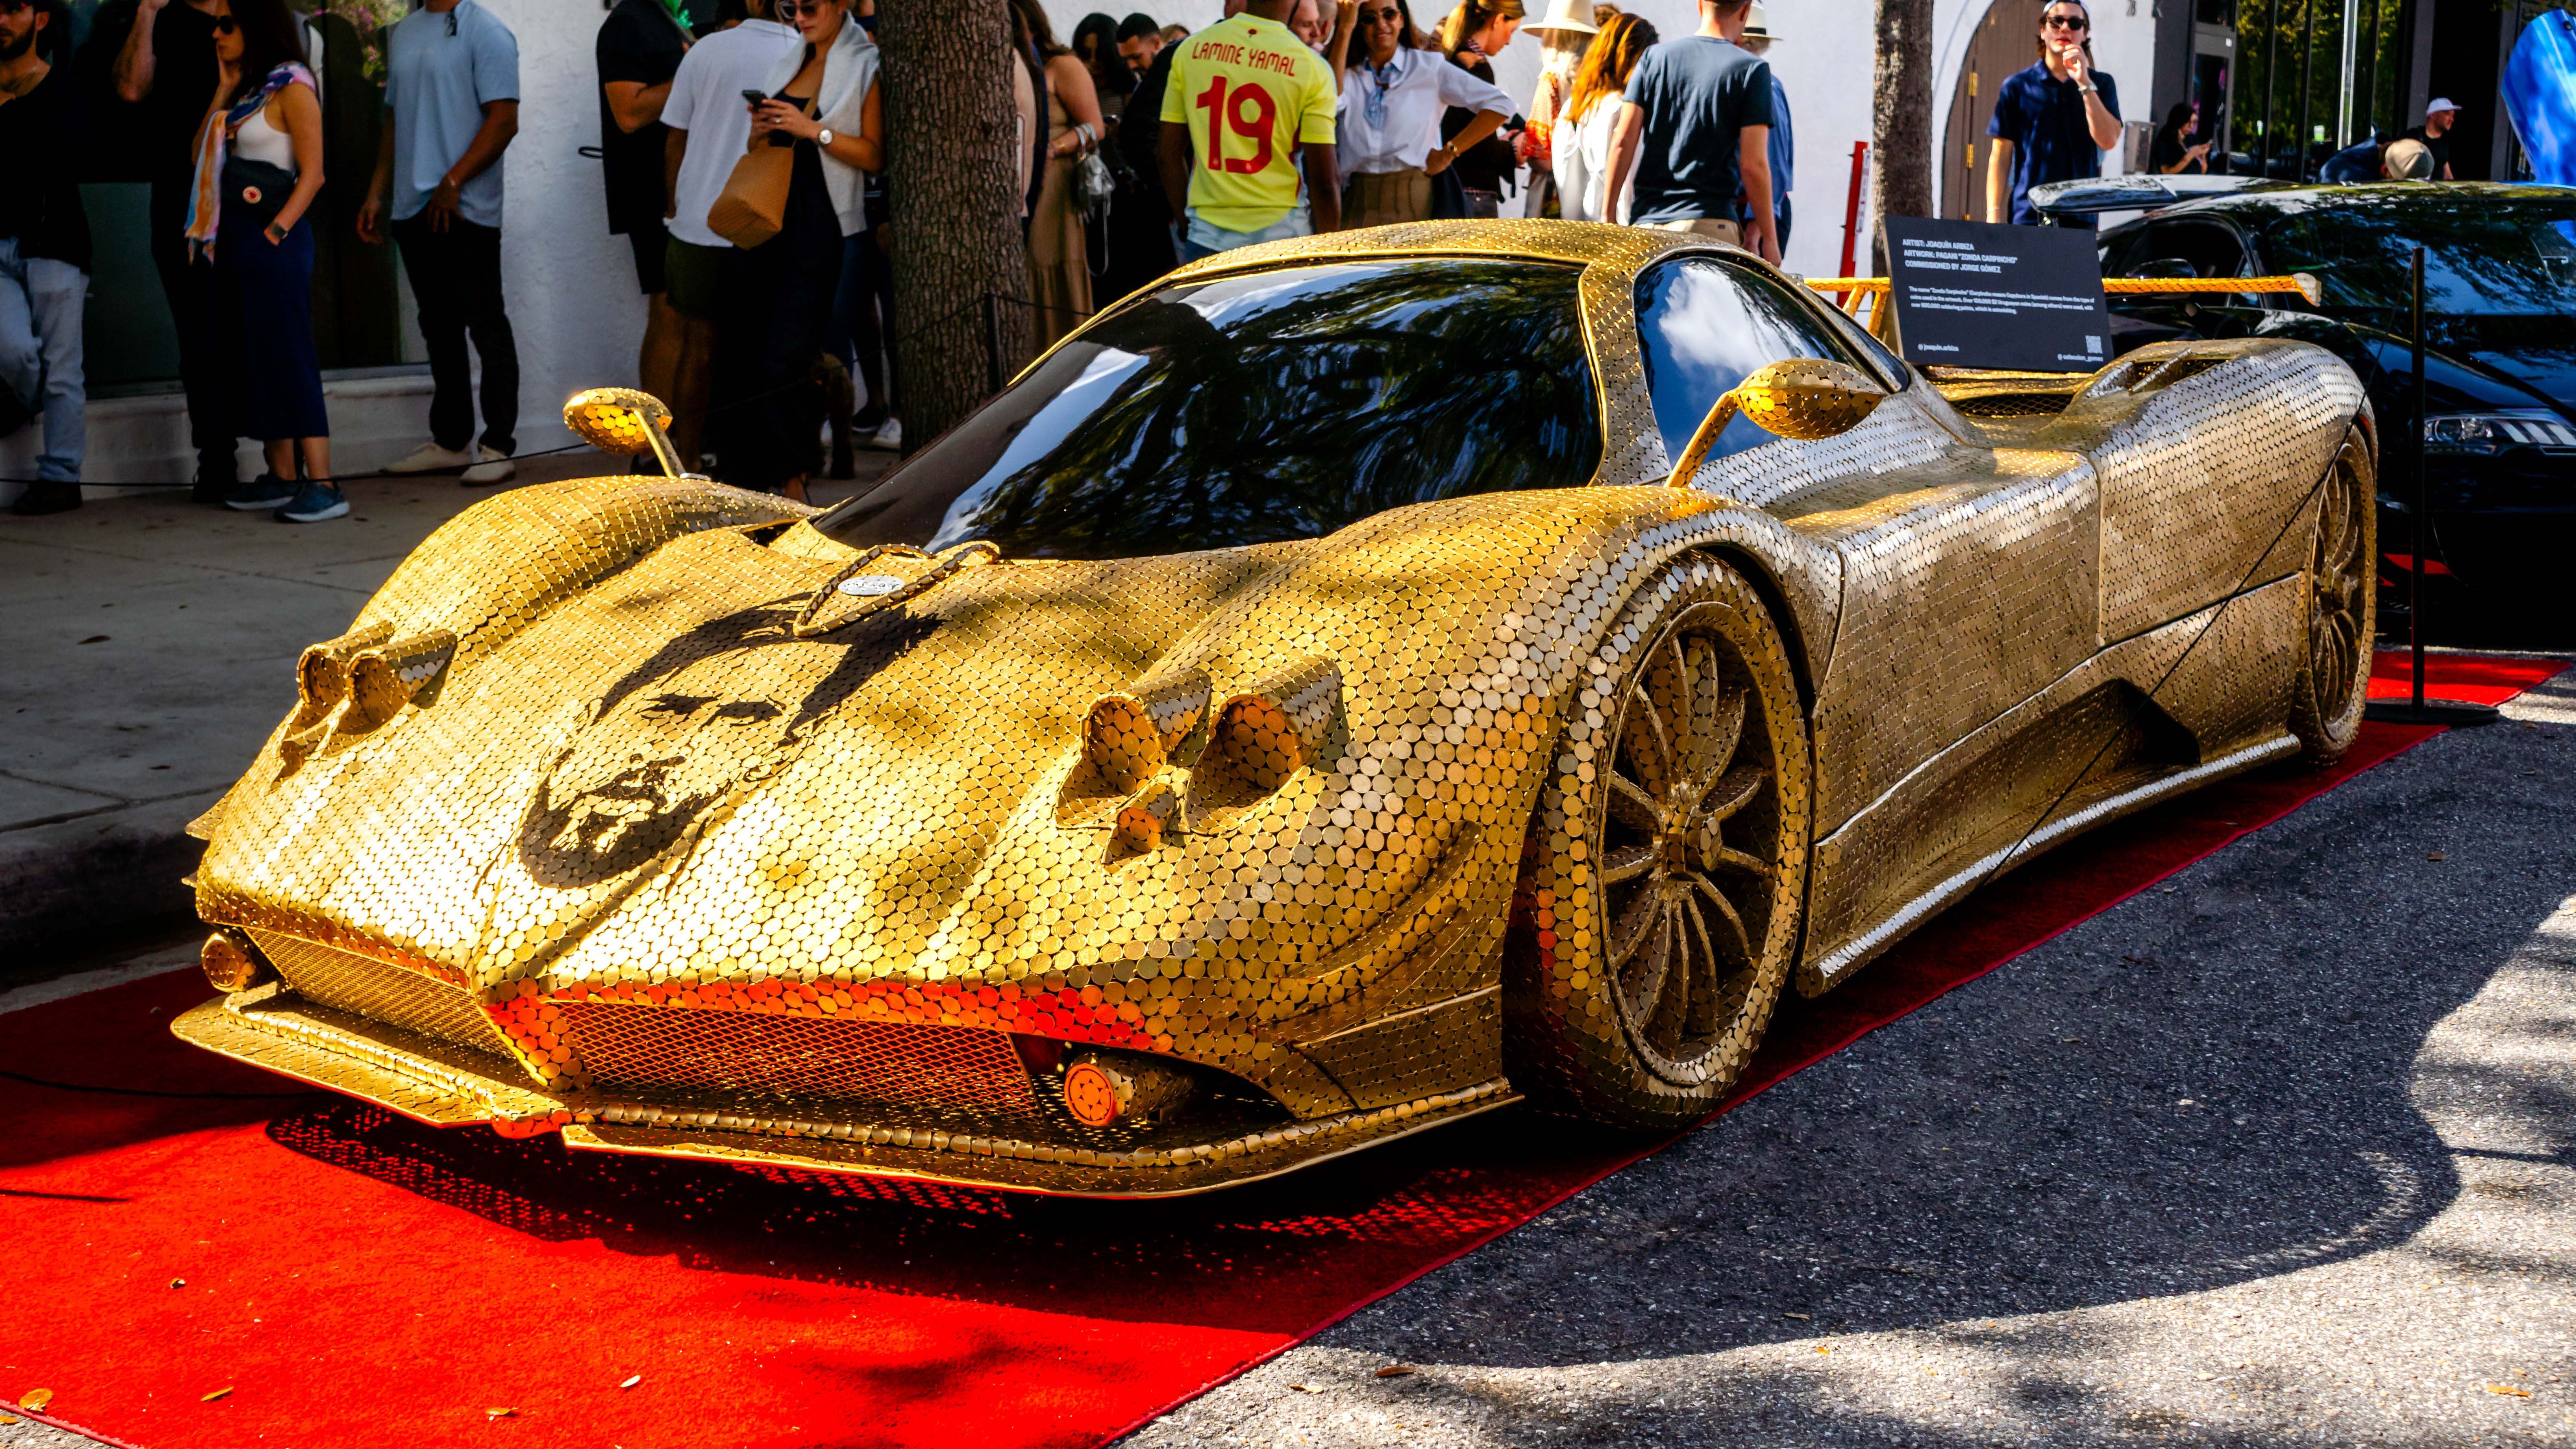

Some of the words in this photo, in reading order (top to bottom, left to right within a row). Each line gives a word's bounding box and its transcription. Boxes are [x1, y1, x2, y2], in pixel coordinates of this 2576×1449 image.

[1192, 42, 1244, 65] LAMINE
[1248, 48, 1295, 77] YAMAL
[1197, 76, 1276, 174] 19
[1904, 250, 1935, 258] ARTWORK:
[1905, 260, 1951, 270] COMMISSIONED
